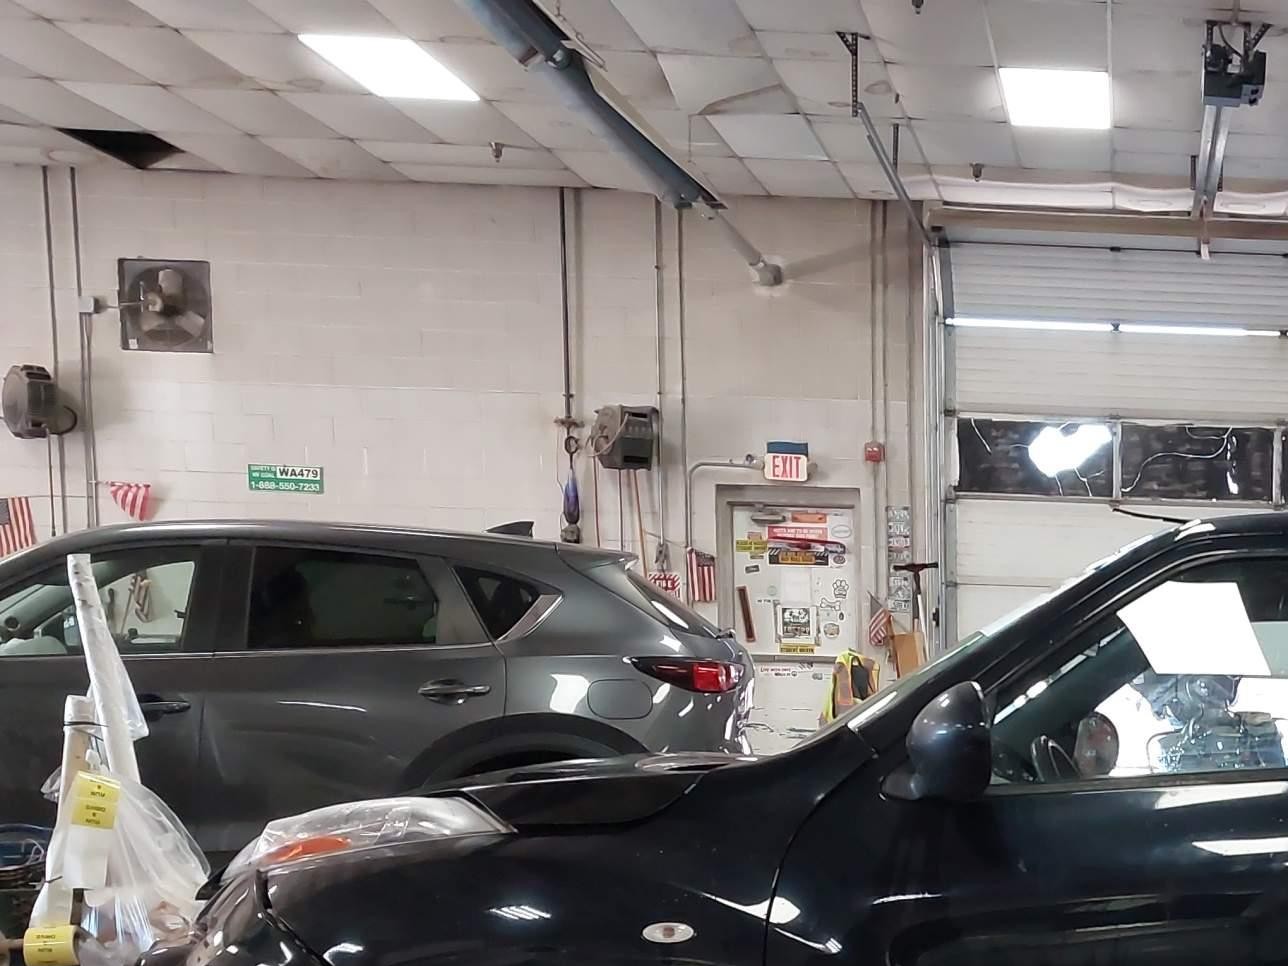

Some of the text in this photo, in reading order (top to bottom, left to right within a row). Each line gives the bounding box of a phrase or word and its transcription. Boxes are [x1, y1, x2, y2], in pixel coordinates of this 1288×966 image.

[772, 455, 801, 479] EXIT
[279, 468, 318, 478] WA479
[250, 481, 319, 491] 1-888-550-7233
